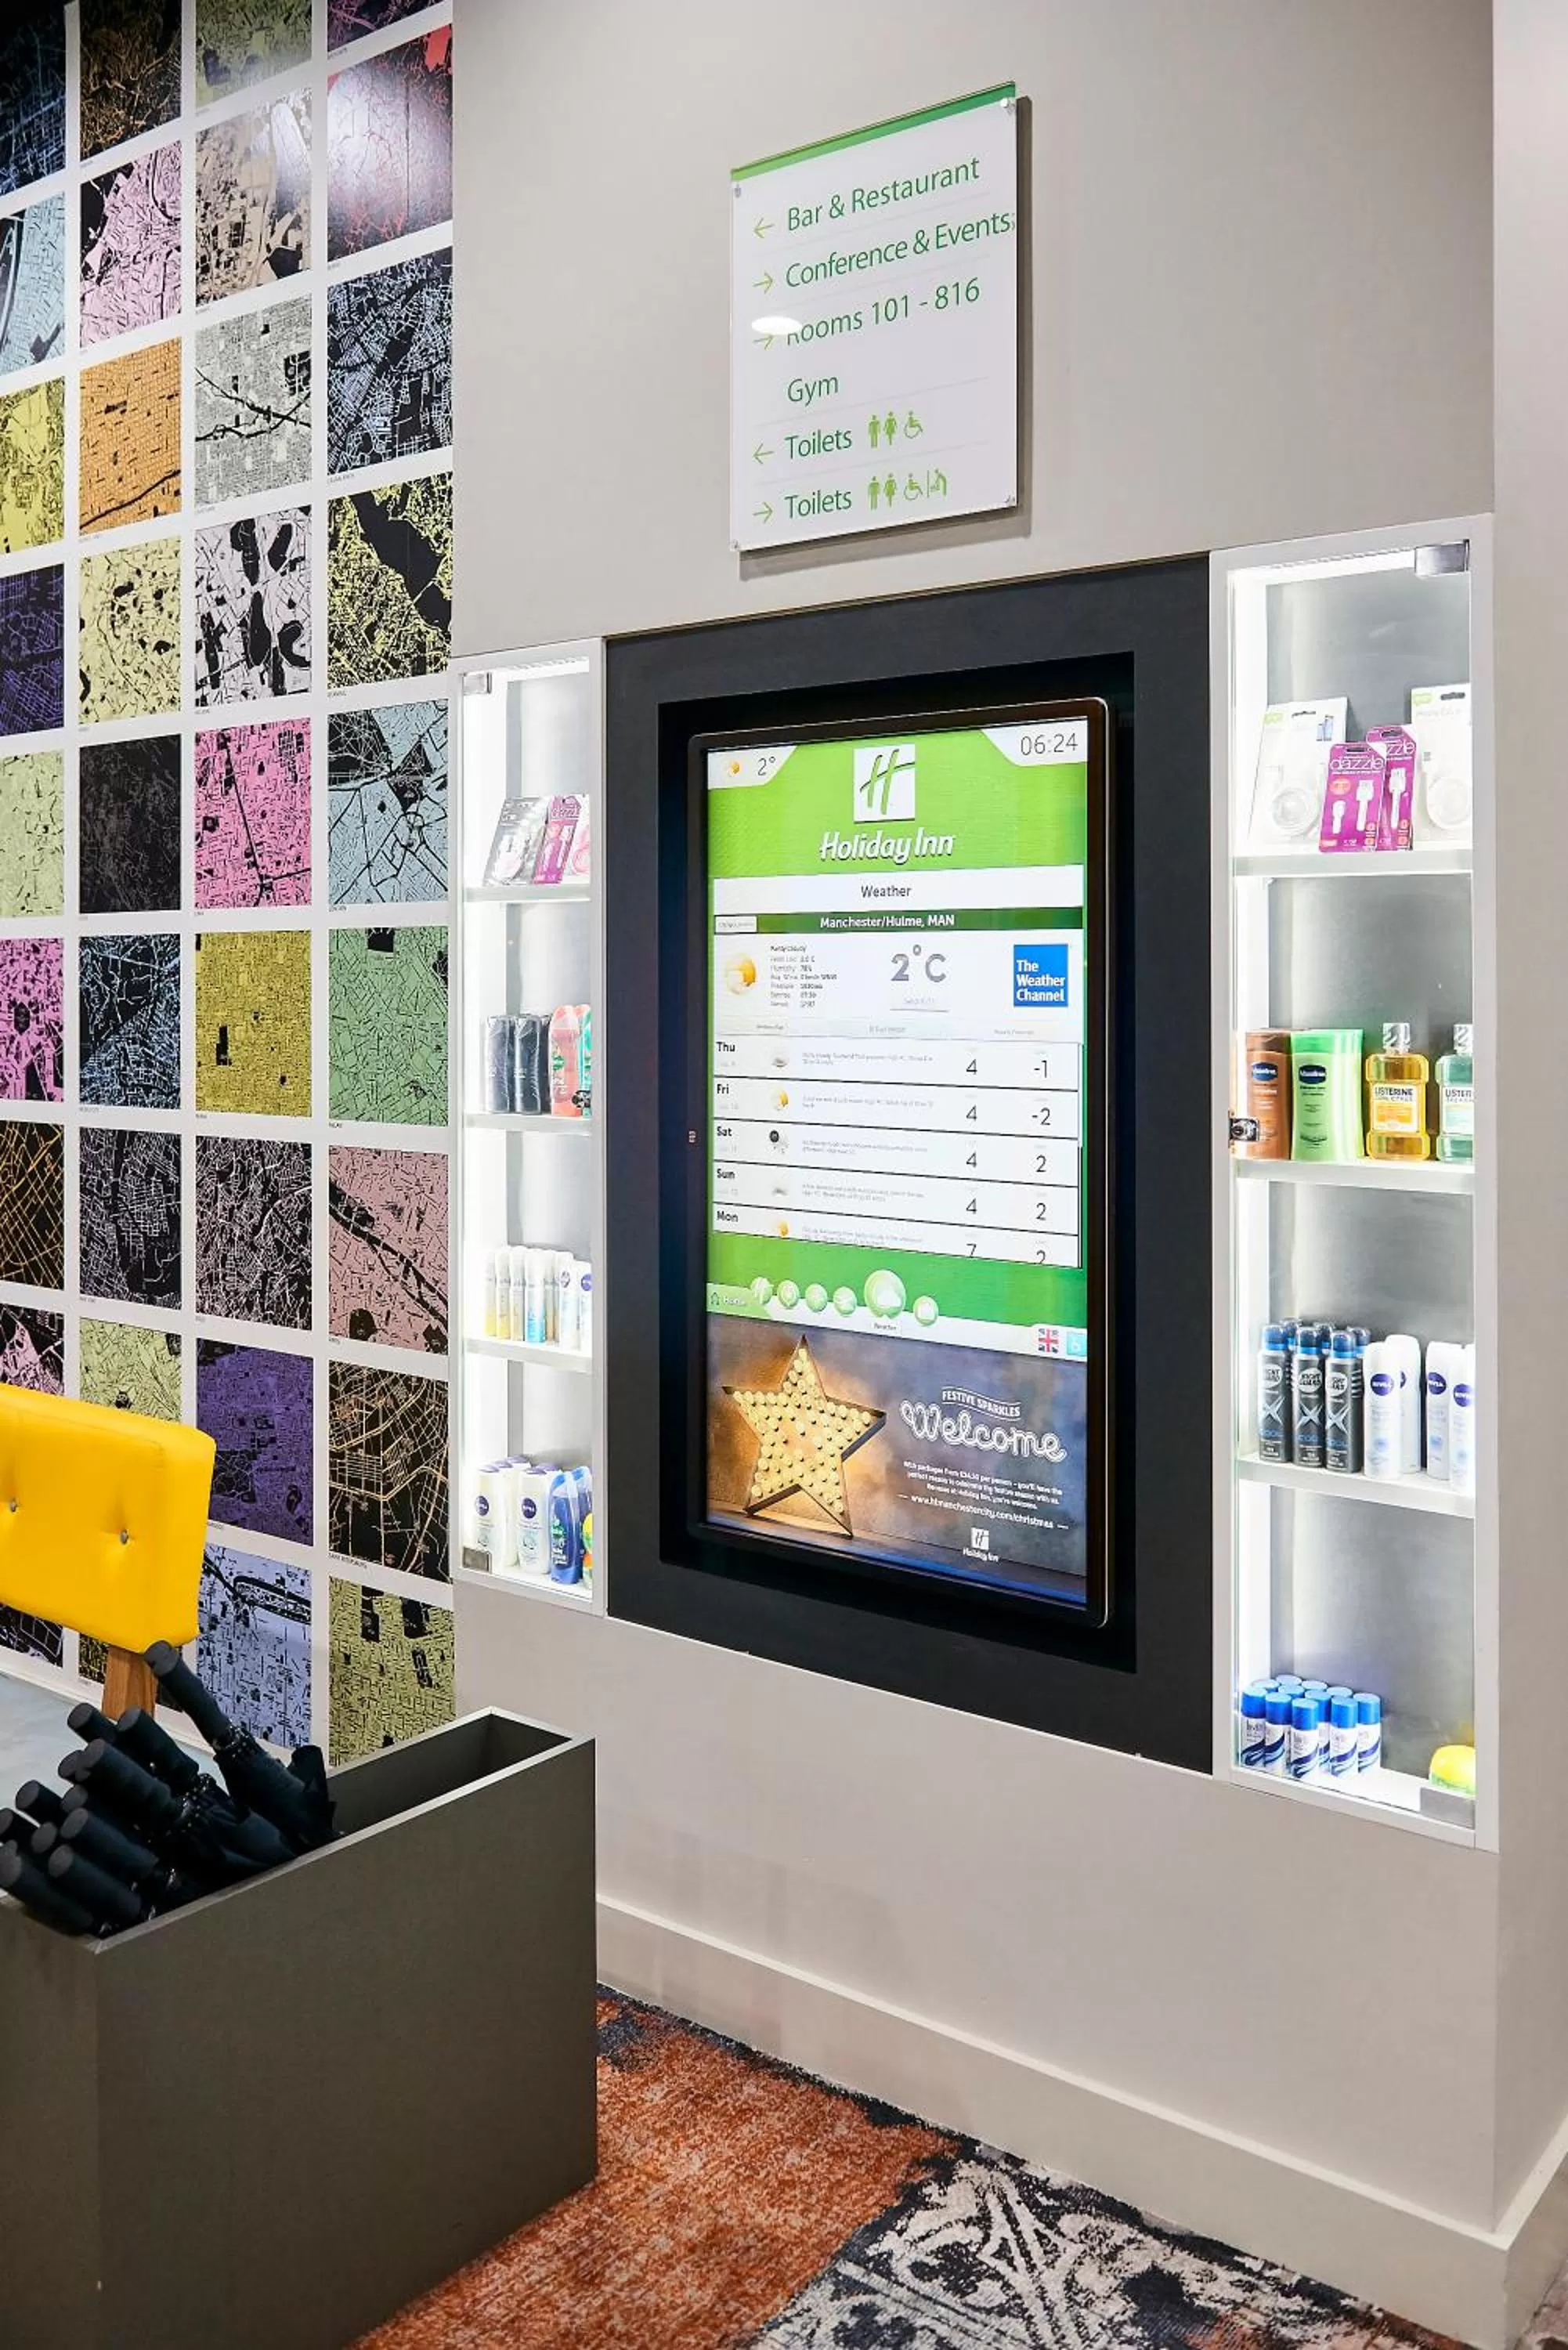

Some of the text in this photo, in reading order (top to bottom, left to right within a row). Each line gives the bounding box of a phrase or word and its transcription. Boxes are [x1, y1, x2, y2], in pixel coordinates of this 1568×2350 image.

[788, 157, 980, 231] Bar & Restaurant
[786, 212, 1010, 288] Conference & Events
[873, 295, 909, 325] 101
[935, 277, 980, 309] 816
[787, 375, 839, 406] Gym
[785, 427, 852, 460] Toilets
[785, 487, 852, 519] Toilets
[1021, 733, 1078, 756] 06:24
[819, 827, 955, 864] Holiday Inn
[861, 885, 912, 898] Weather
[927, 915, 955, 926] MAN
[1017, 960, 1039, 972] The
[1017, 974, 1065, 986] Weather
[1017, 989, 1064, 1002] Channel
[716, 1041, 735, 1052] Thu
[966, 1058, 978, 1075] 4
[1033, 1060, 1048, 1078] -1
[717, 1083, 729, 1094] Fri
[1375, 1087, 1413, 1097] LISTERINE
[966, 1104, 978, 1121] 4
[1031, 1108, 1051, 1126] -2
[717, 1127, 732, 1137] Sat
[966, 1152, 978, 1168] 4
[1036, 1155, 1047, 1173] 2
[717, 1170, 735, 1180] Sun
[966, 1198, 978, 1215] 4
[1036, 1203, 1047, 1221] 2
[717, 1212, 739, 1223] Mon
[942, 1390, 1021, 1417] FESTIVE SPARKLES
[900, 1400, 1068, 1462] Welcome
